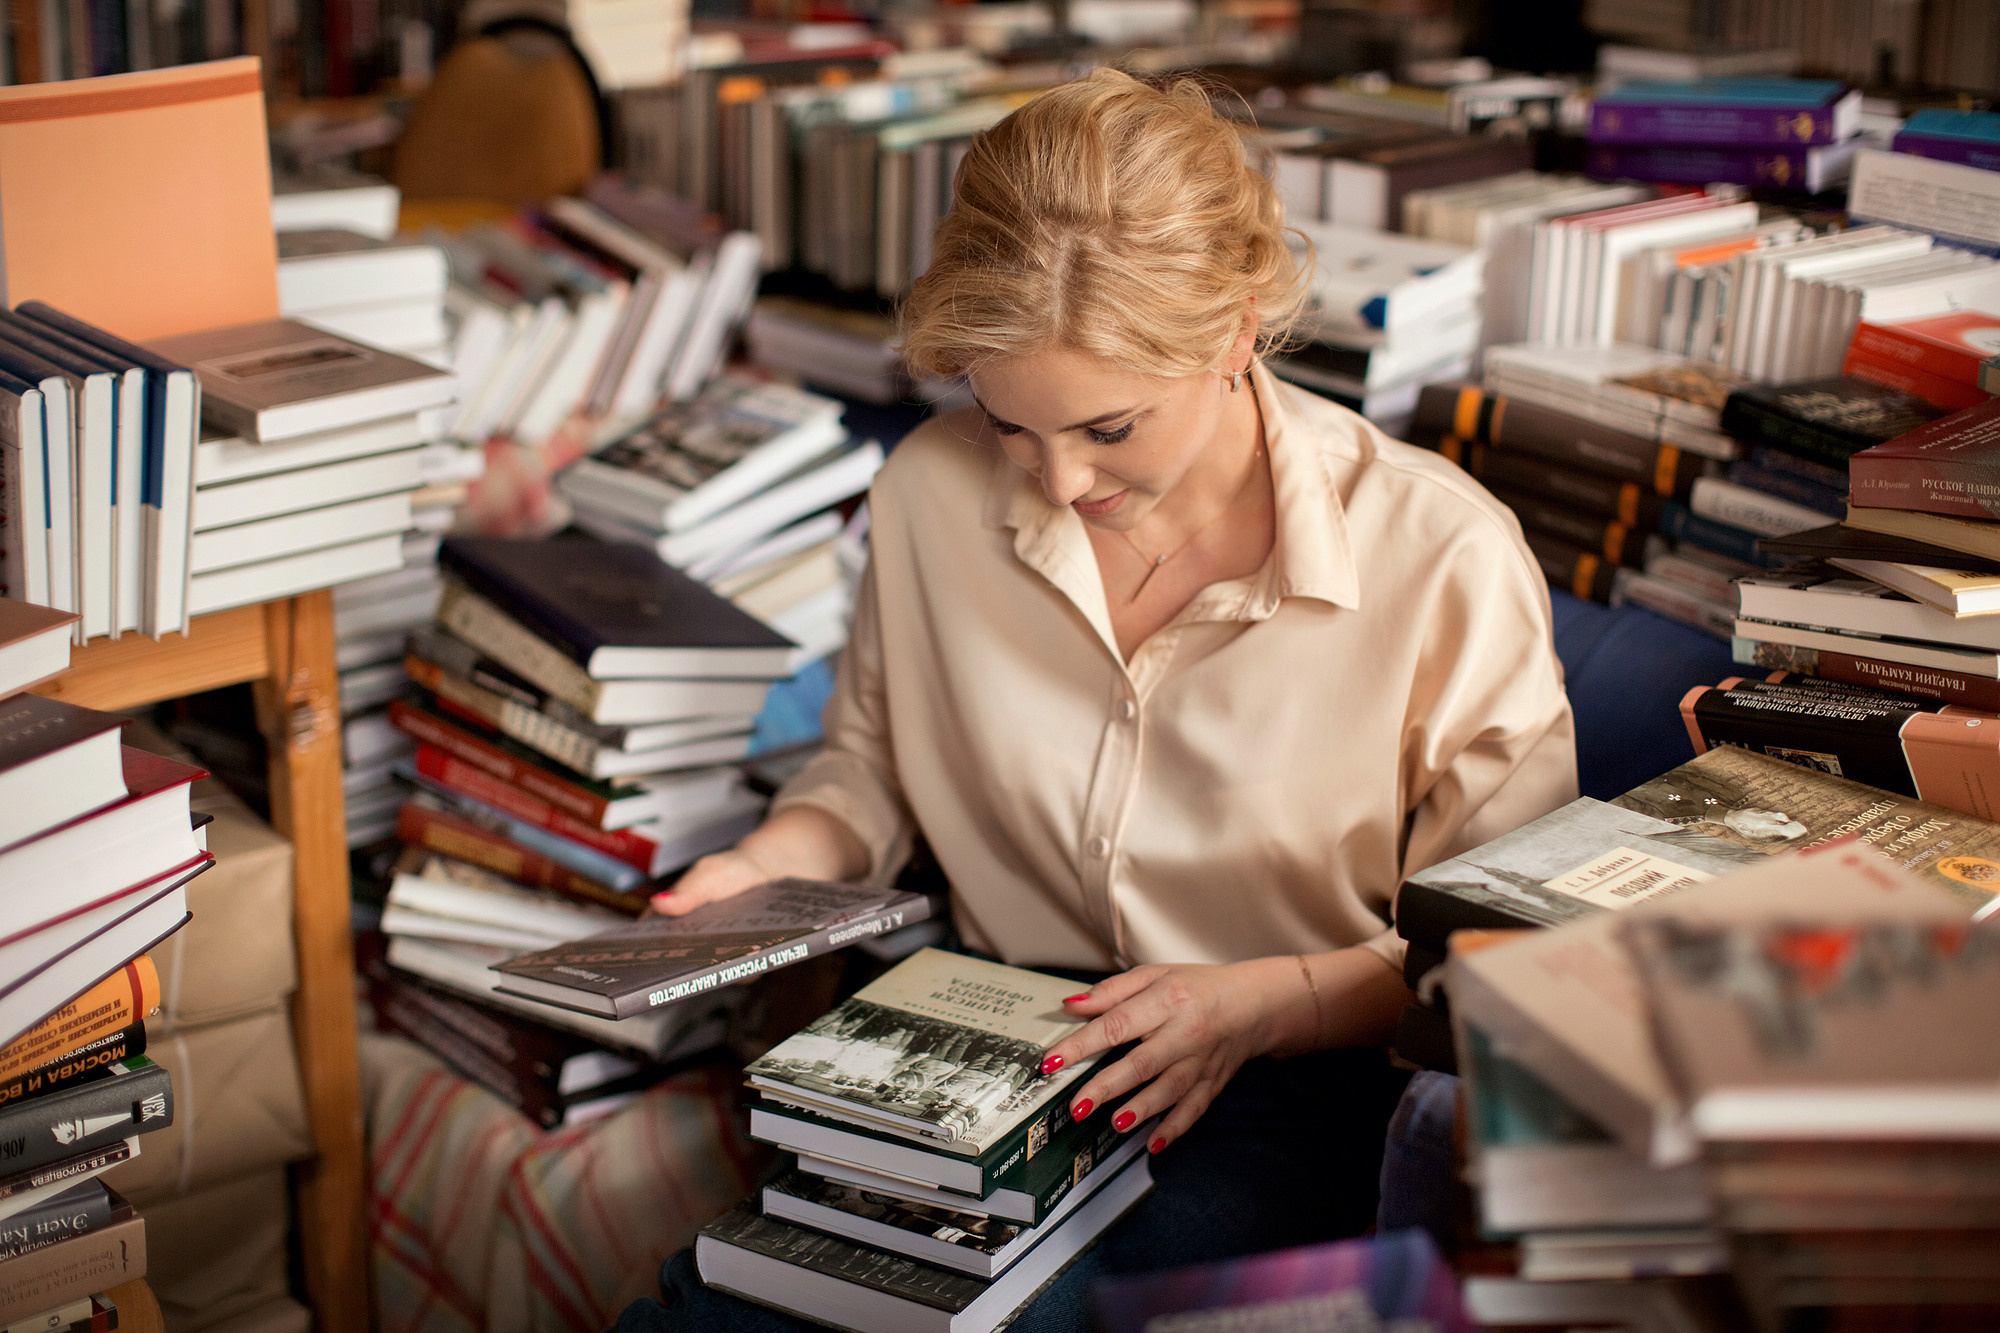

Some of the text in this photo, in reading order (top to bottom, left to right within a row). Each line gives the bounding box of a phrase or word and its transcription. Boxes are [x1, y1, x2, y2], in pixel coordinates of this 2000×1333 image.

[1922, 478, 1965, 492] РУССКОЕ
[1930, 491, 1974, 505] Жизненный
[1855, 660, 1966, 691] ГВАРДИИ КАМЧАТКА
[1723, 691, 1799, 707] ОБРАЗОВАНИИ
[1911, 683, 1941, 698] Николай
[1733, 698, 1806, 715] КРУПНЕЙШИХ
[1799, 700, 1814, 710] ОБ
[1805, 707, 1868, 721] ПЯТЬДЕСЯТ
[1815, 702, 1889, 717] МЫСЛИТЕЛЕЙ
[1884, 818, 1951, 854] Мифы и
[1588, 856, 1634, 878] Добренко
[1608, 868, 1671, 900] ПОЗДНИЙ
[891, 911, 904, 927] А.
[828, 918, 883, 946] Менделеев
[717, 951, 768, 983] РУССКИХ
[768, 943, 808, 969] ПЕЧАТЬ
[649, 971, 718, 1007] АНАРХИСТОВ
[947, 987, 1015, 1009] БЕЛОГО
[949, 976, 1035, 1004] ОФИЦЕРА
[929, 990, 1016, 1017] ЗАПИСКИ
[58, 1002, 112, 1032] НЕМЕЦКИЕ
[67, 1008, 129, 1041] ЛАТЫШСКИЕ
[22, 1038, 65, 1063] «ЛЕСНЫЕ
[46, 1044, 126, 1084] МОСКВА
[28, 1076, 42, 1092] И
[142, 1092, 166, 1123] ЖЗЛ
[0, 1136, 26, 1161] ЛОБ
[88, 1156, 106, 1169] Е.В.
[31, 1163, 87, 1188] СУРОВЦЕВА
[0, 1213, 89, 1245] Элен Ка
[89, 1250, 115, 1263] Труды
[47, 1261, 116, 1291] КОНСПЕКТ
